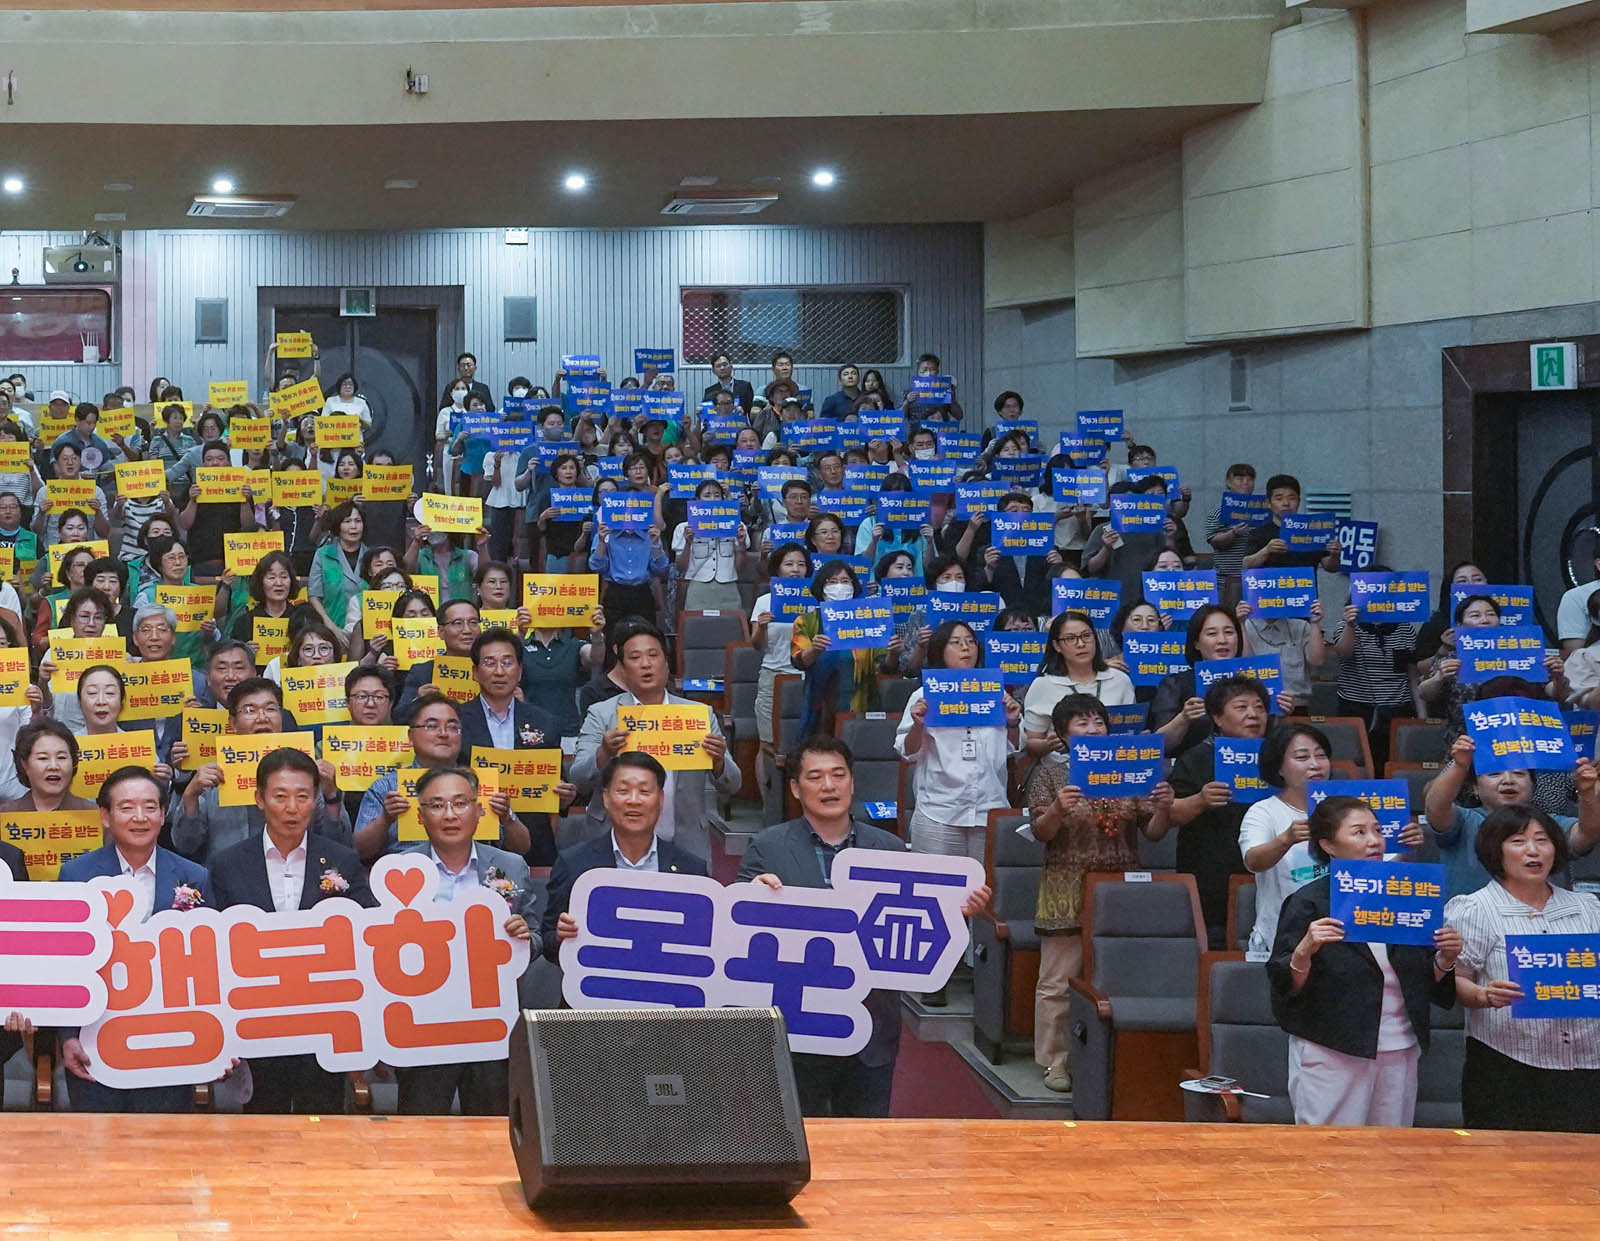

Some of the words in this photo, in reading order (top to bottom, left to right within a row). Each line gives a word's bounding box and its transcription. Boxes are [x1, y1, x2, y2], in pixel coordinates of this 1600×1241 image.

[528, 584, 557, 596] 모두가
[558, 583, 576, 596] 존중
[577, 586, 594, 596] 받는
[1356, 582, 1387, 593] 모두가
[1388, 580, 1406, 592] 존중
[1407, 582, 1425, 592] 받는
[537, 603, 565, 616] 행복한
[1366, 599, 1395, 612] 행복한
[825, 610, 854, 621] 모두가
[855, 606, 872, 619] 존중
[872, 608, 890, 617] 받는
[837, 626, 864, 639] 행복한
[1460, 638, 1496, 649] 모두가
[1497, 635, 1518, 649] 존중
[1519, 638, 1540, 648] 받는
[4, 660, 24, 672] 받는
[1473, 657, 1507, 671] 행복한
[927, 680, 959, 692] 모두가
[960, 678, 980, 692] 존중
[980, 681, 1000, 691] 받는
[938, 700, 969, 714] 행복한
[1472, 712, 1516, 728] 모두가
[1517, 708, 1543, 727] 존중
[1542, 714, 1564, 728] 받는
[1492, 737, 1533, 754] 행복한
[1076, 748, 1113, 761] 모두가
[1115, 745, 1137, 760] 존중
[1139, 748, 1161, 760] 받는
[1087, 769, 1122, 785] 행복한
[1338, 875, 1383, 894] 모두가
[1385, 875, 1412, 896] 존중
[1414, 881, 1440, 897] 받는
[1353, 905, 1395, 926] 행복한
[97, 868, 513, 1071] 행복한
[577, 885, 859, 1039] 목포
[654, 1083, 679, 1096] JBL
